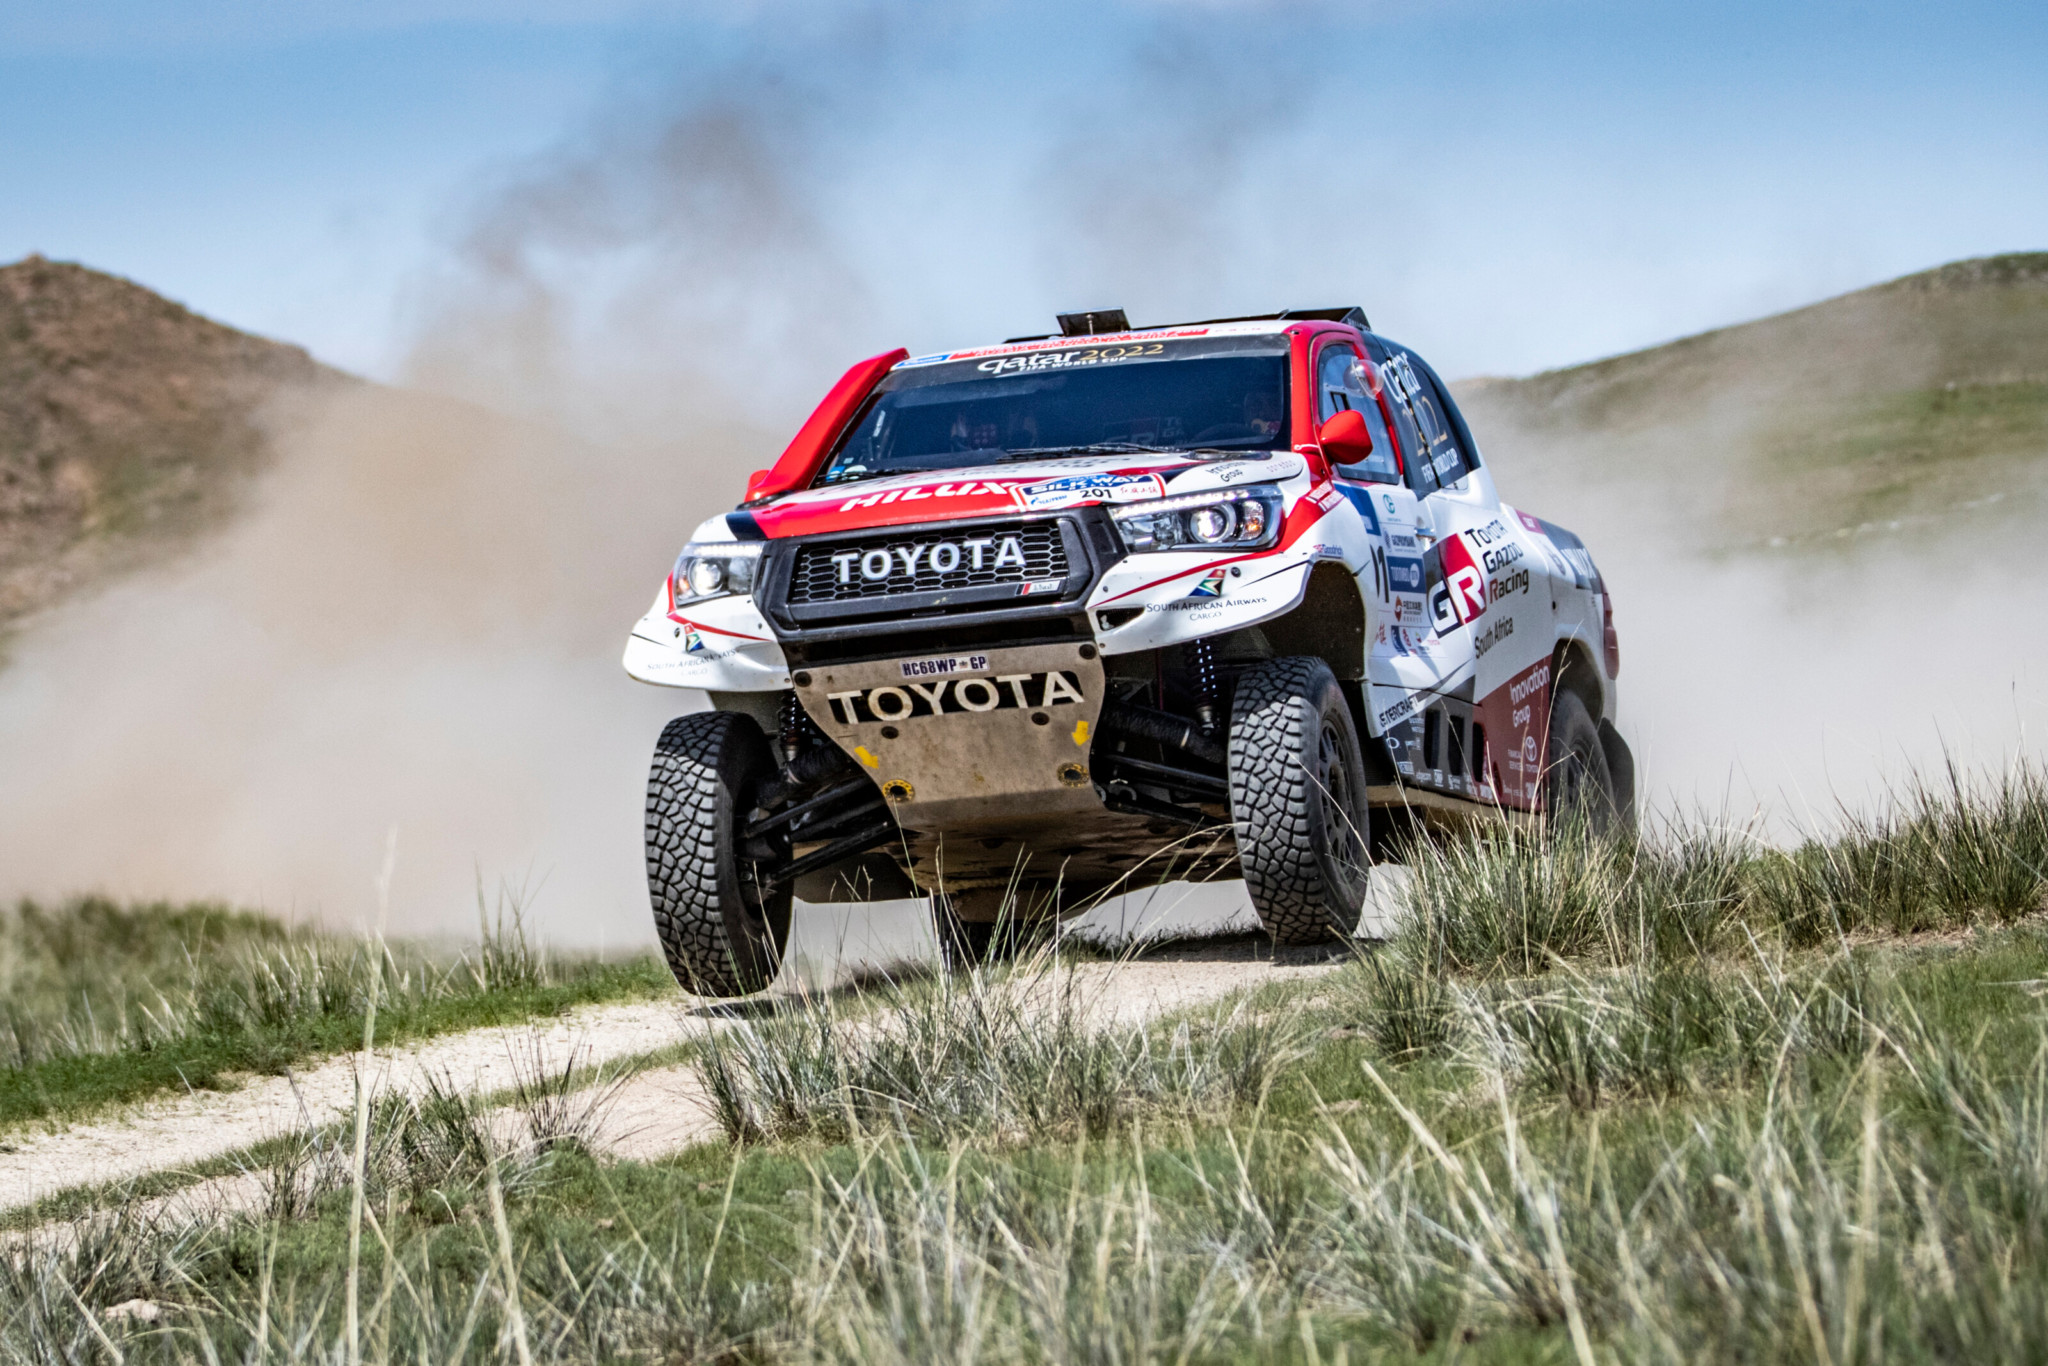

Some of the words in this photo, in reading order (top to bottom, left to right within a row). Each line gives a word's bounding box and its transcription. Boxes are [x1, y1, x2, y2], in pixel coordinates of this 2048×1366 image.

[977, 350, 1081, 374] qatar
[1079, 344, 1164, 362] 2022
[1018, 364, 1048, 373] FIFA
[1051, 359, 1098, 370] WORLD
[1101, 356, 1128, 364] CUP
[839, 482, 1020, 512] HILUX
[1031, 479, 1087, 494] SILK
[1092, 474, 1144, 485] WAY
[1080, 488, 1112, 499] 201
[831, 537, 1026, 584] TOYOTA
[1427, 565, 1487, 634] GR
[1488, 568, 1530, 604] Racing
[1146, 602, 1180, 613] SOUTH
[1180, 601, 1224, 612] AFRICAN
[1225, 596, 1268, 607] AIRWAYS
[1189, 611, 1223, 621] CARGO
[1474, 621, 1495, 660] South
[1493, 616, 1514, 647] Africa
[902, 658, 957, 676] HC68WP
[969, 656, 986, 670] GP
[827, 671, 1084, 725] TOYOTA
[1510, 665, 1550, 705] Innovation
[1513, 704, 1531, 728] Group
